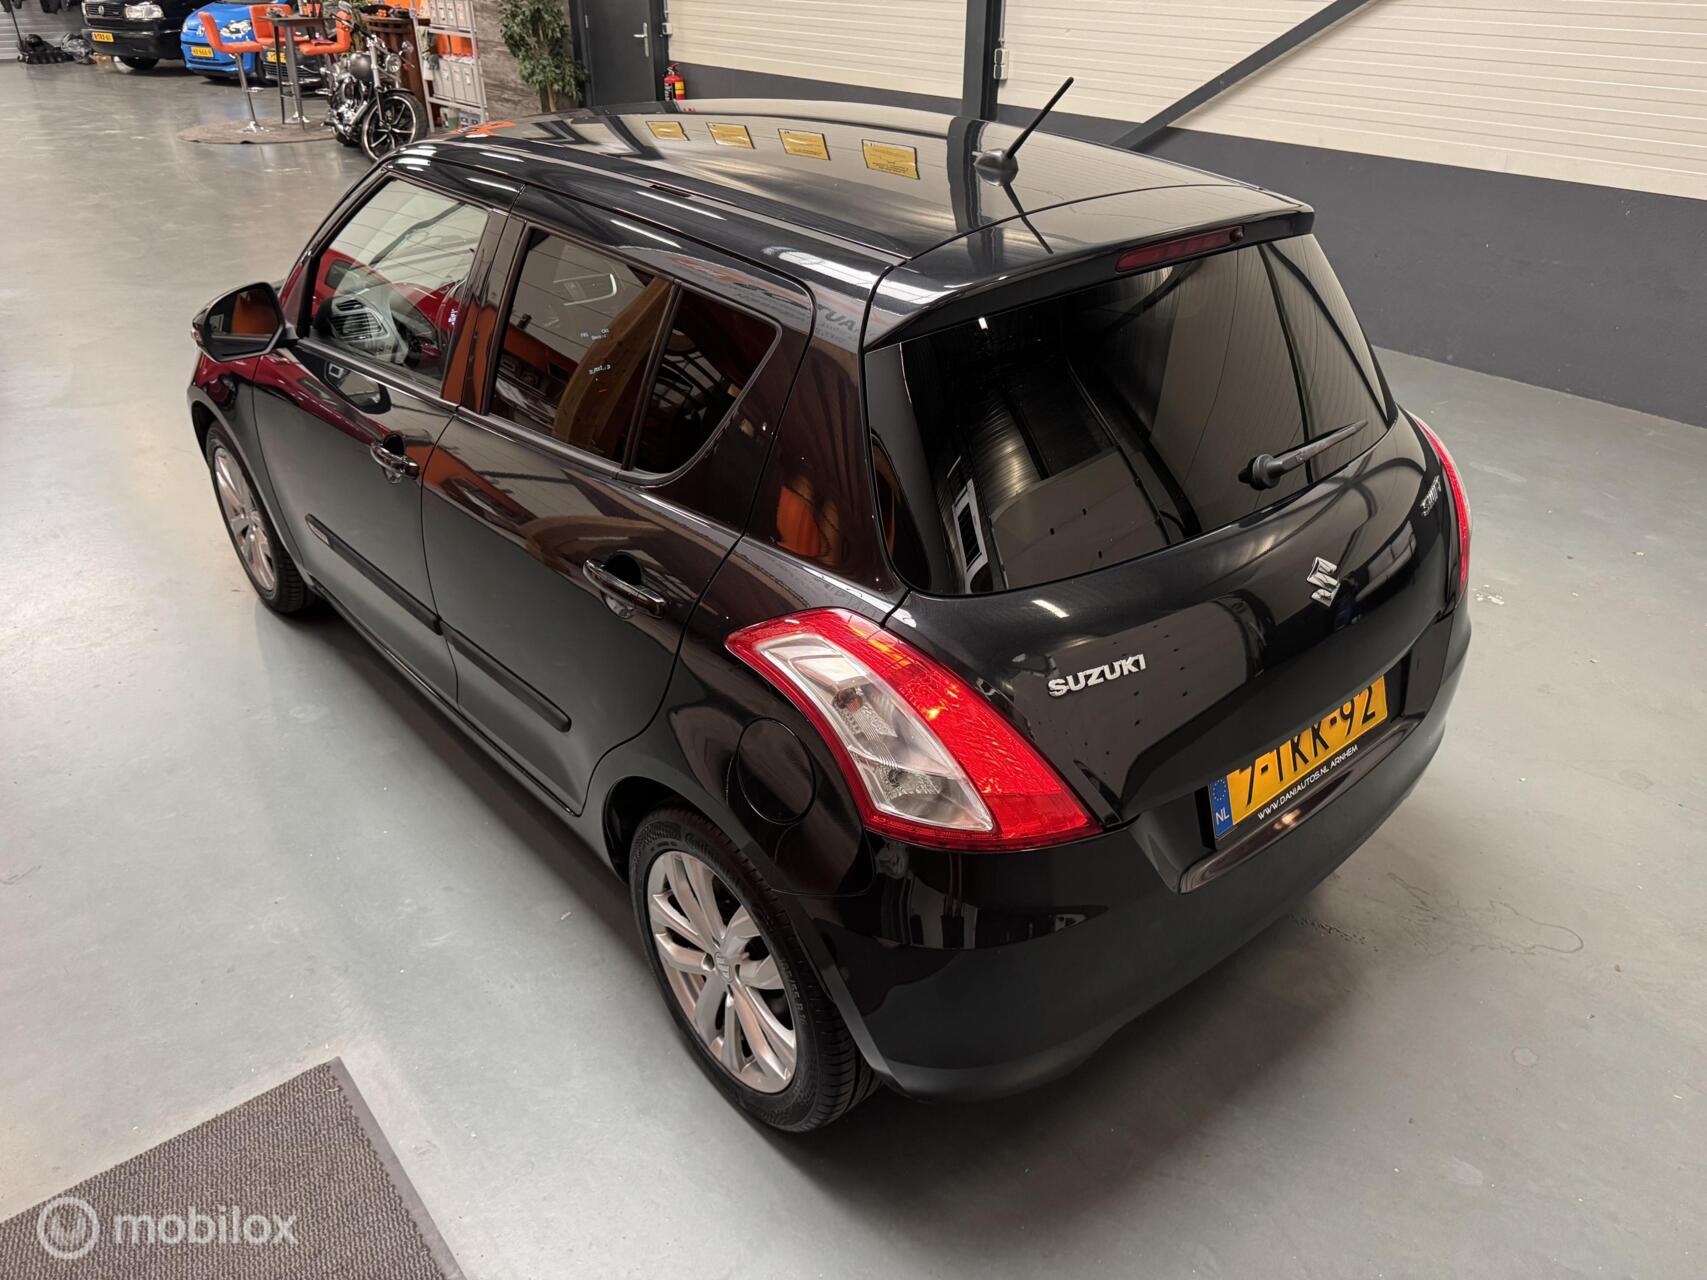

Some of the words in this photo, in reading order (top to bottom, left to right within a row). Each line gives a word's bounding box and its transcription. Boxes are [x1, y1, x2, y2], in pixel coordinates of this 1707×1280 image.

[1047, 653, 1147, 697] SUZUKI
[1257, 766, 1330, 820] WWW.DANIAUTOS.NL
[1330, 744, 1359, 768] ARNHEM
[1215, 807, 1230, 825] NL
